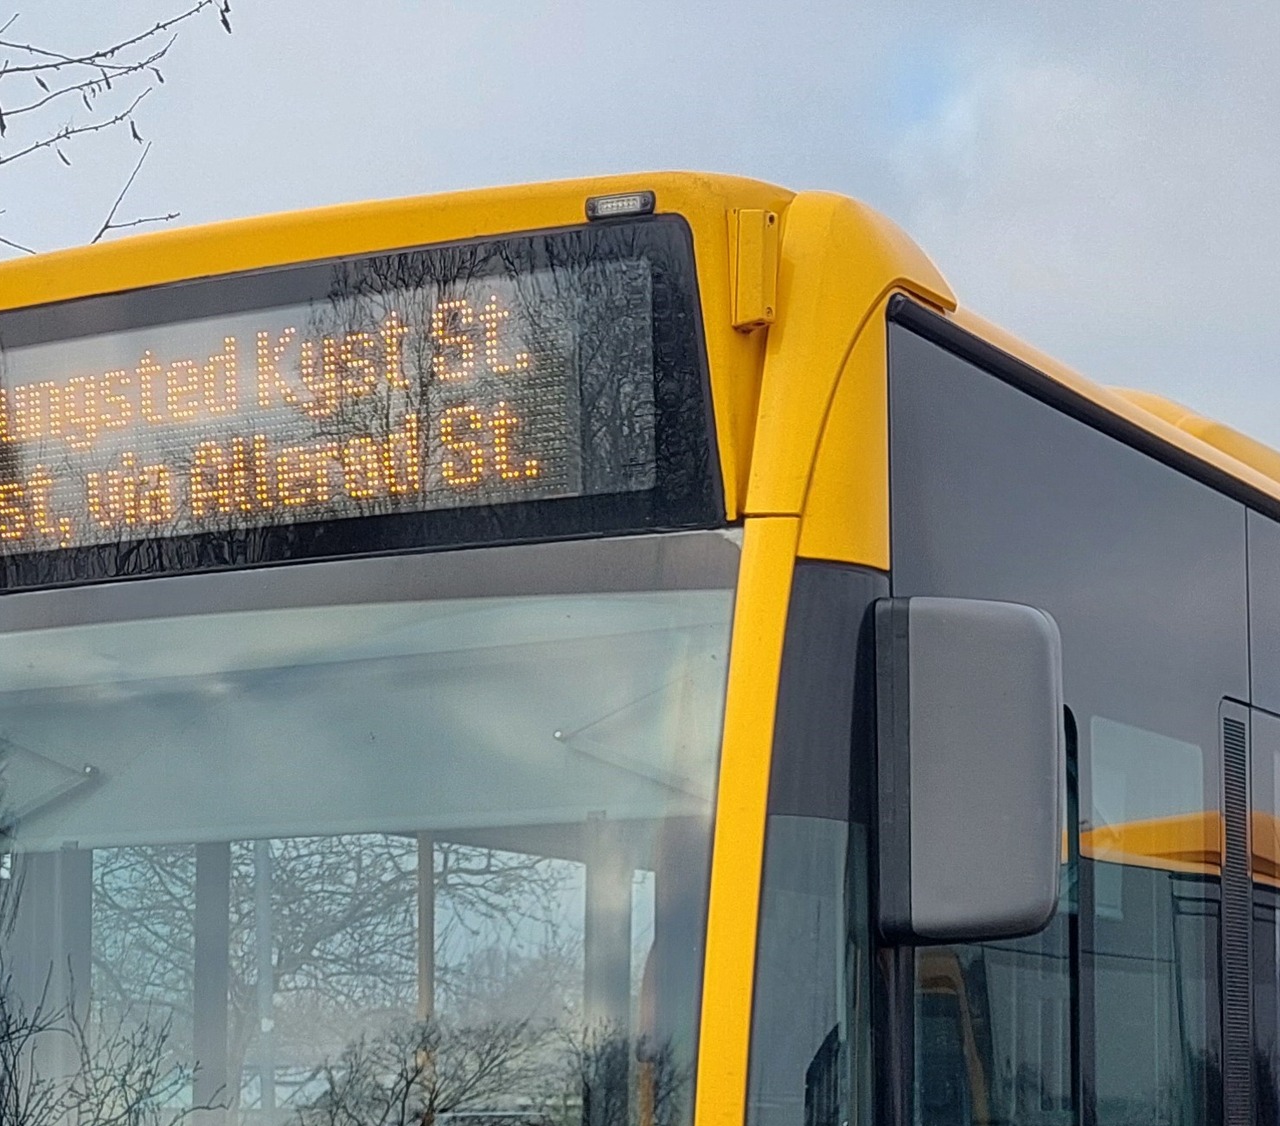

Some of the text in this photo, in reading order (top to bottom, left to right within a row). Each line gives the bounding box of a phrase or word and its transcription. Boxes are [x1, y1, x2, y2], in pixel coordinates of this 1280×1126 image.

[255, 310, 411, 417] Kyst
[431, 295, 530, 381] St.
[86, 450, 173, 528] via
[191, 412, 420, 518] Allerød
[439, 400, 540, 486] St.
